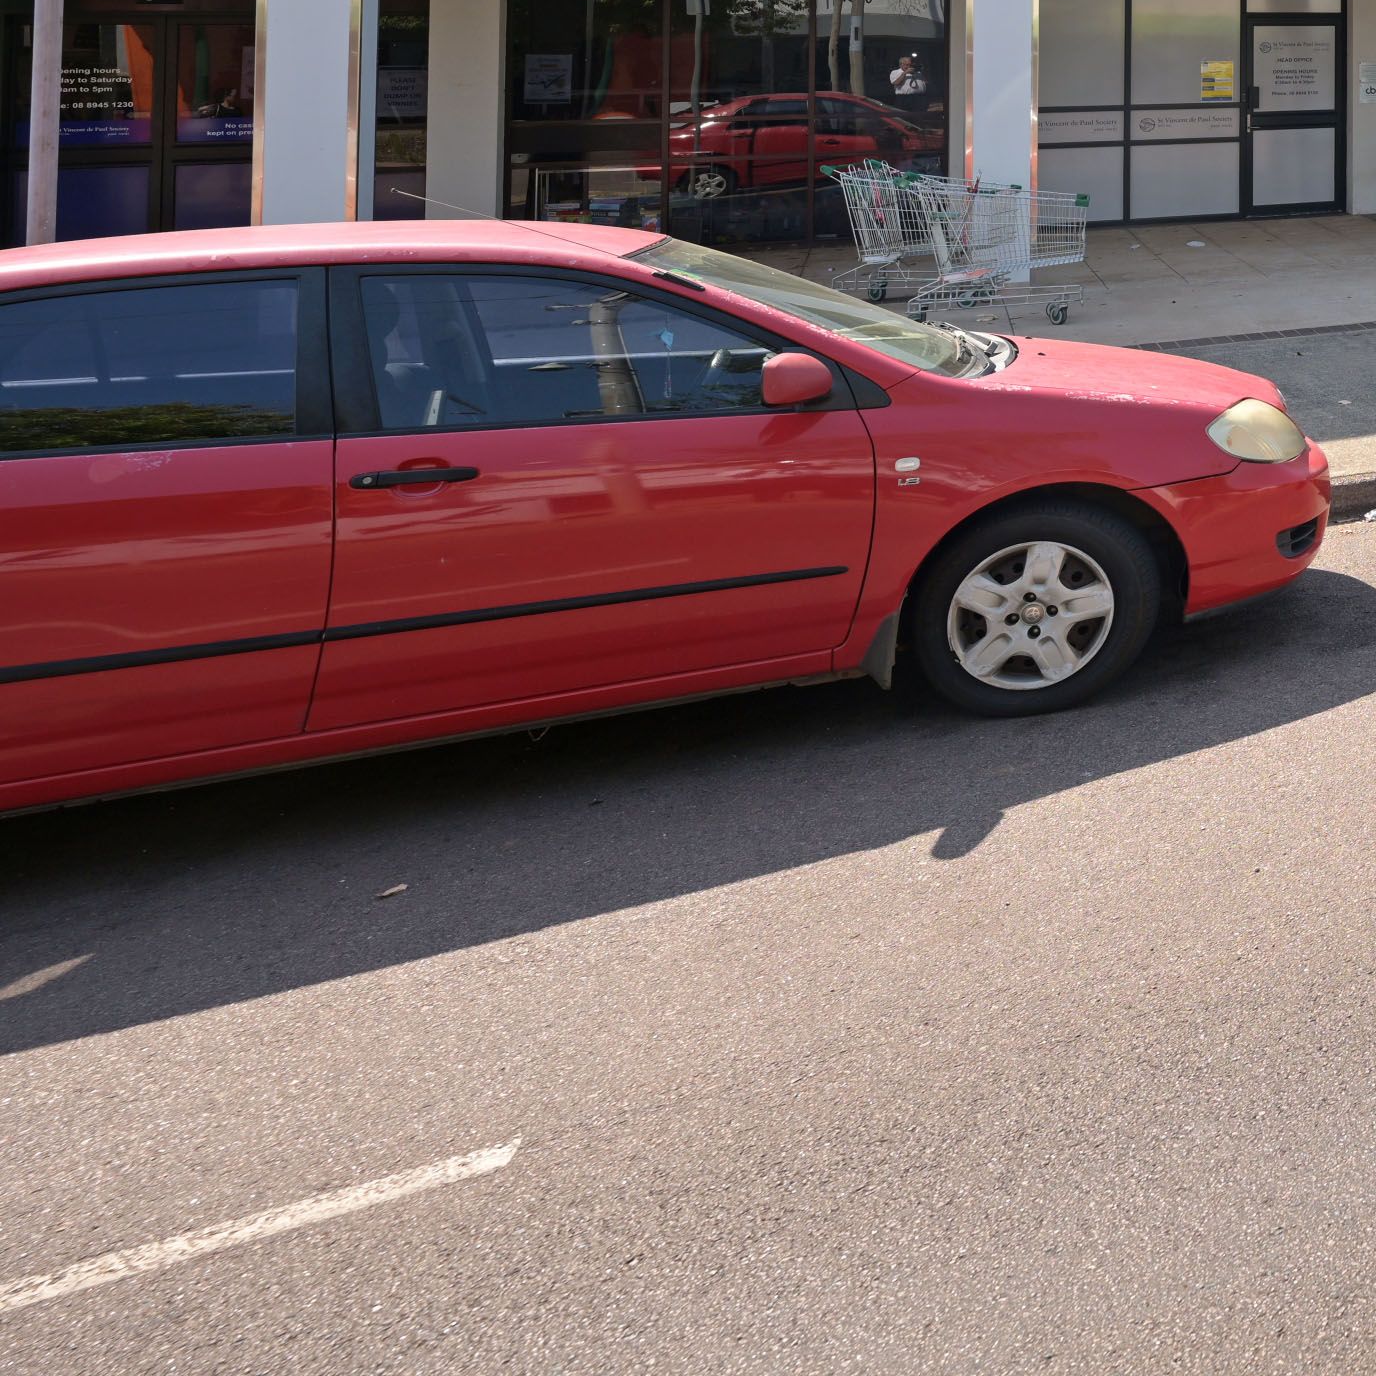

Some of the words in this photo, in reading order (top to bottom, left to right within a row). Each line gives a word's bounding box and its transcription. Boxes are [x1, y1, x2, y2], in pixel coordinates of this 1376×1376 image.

[90, 76, 133, 84] Saturday
[92, 86, 113, 94] 5pm
[112, 100, 134, 108] 1230
